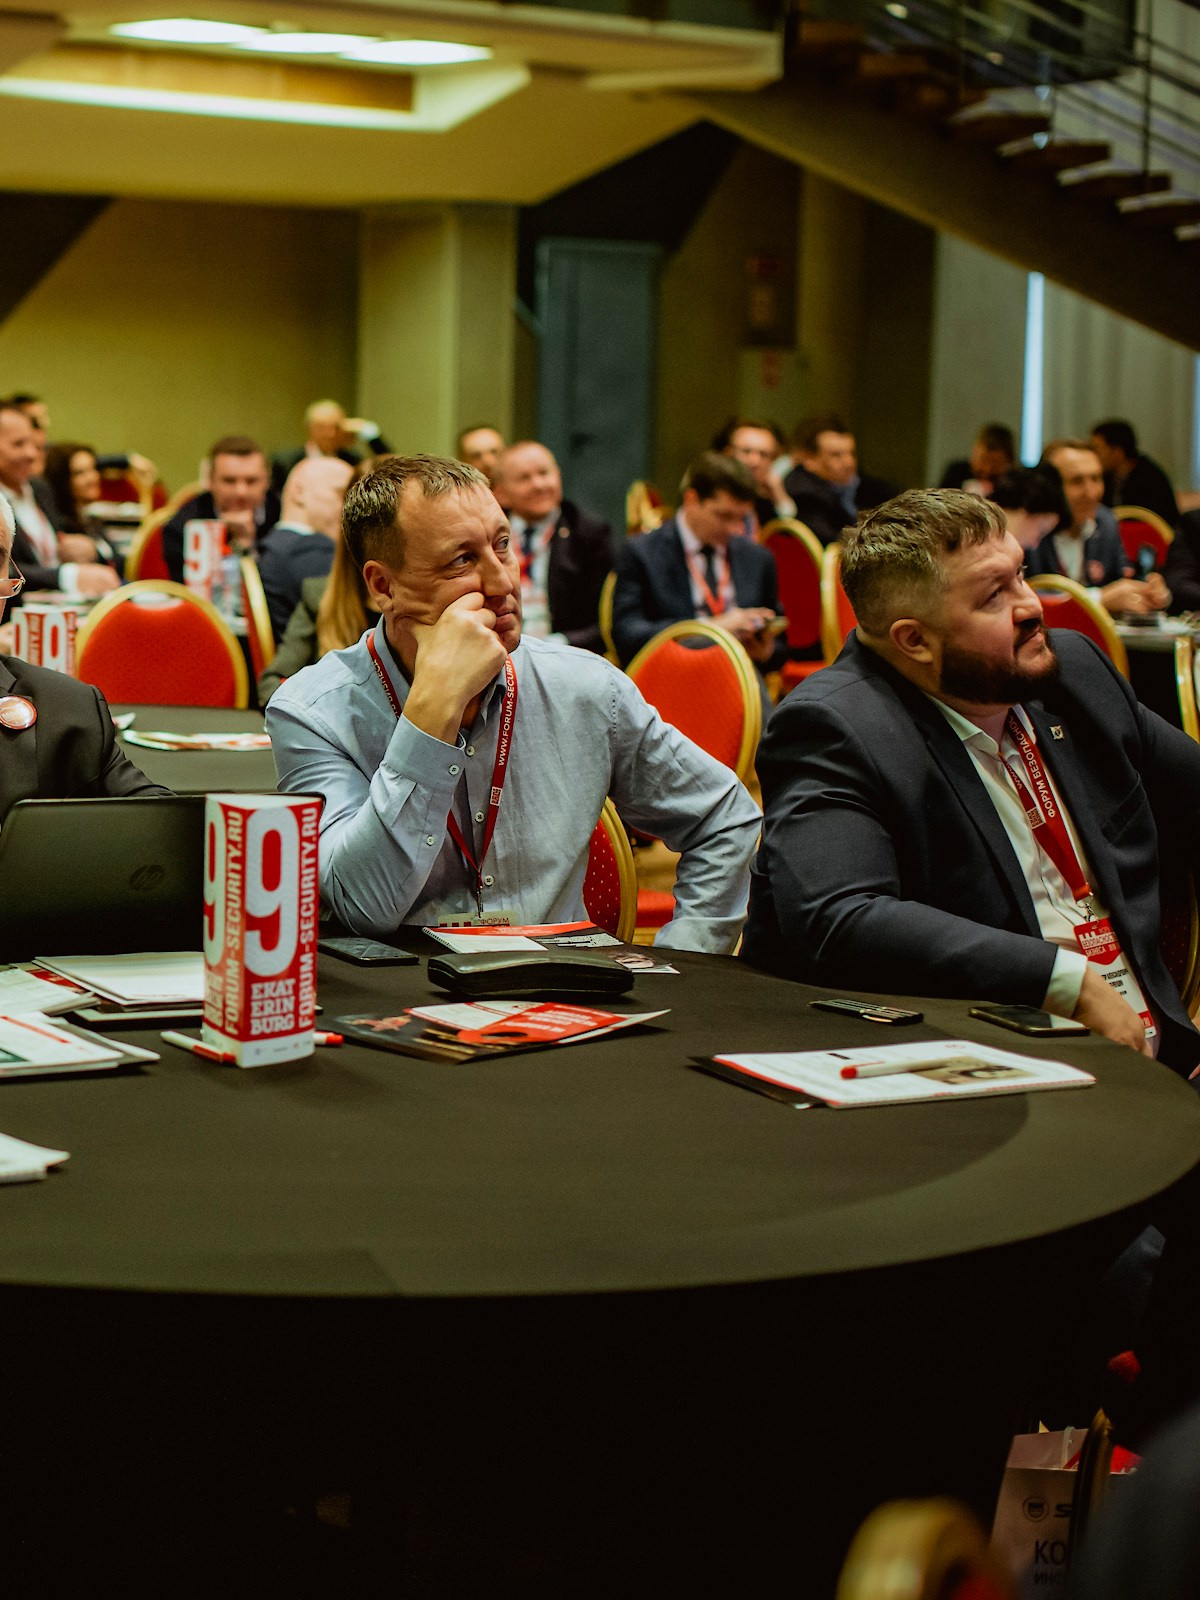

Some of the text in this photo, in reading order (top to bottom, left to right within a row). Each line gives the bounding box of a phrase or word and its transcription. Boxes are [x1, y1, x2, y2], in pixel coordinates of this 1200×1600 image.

[183, 523, 209, 579] 9
[498, 656, 514, 766] WWW.FORUM-SECURIT
[1008, 716, 1041, 779] БЕЗОПАСНОС
[1036, 780, 1056, 818] ФОРУМ
[203, 802, 225, 967] 9
[244, 806, 299, 977] 9
[224, 810, 244, 1036] FORUM-SECURITY.RU
[298, 807, 318, 1029] FORUM-SECURITY.RU
[480, 917, 510, 925] ФОРУМ
[250, 995, 295, 1017] ERIN
[251, 978, 296, 1000] EKAT
[250, 1013, 295, 1036] BURG
[1054, 1503, 1073, 1518] S
[1034, 1540, 1066, 1566] КО
